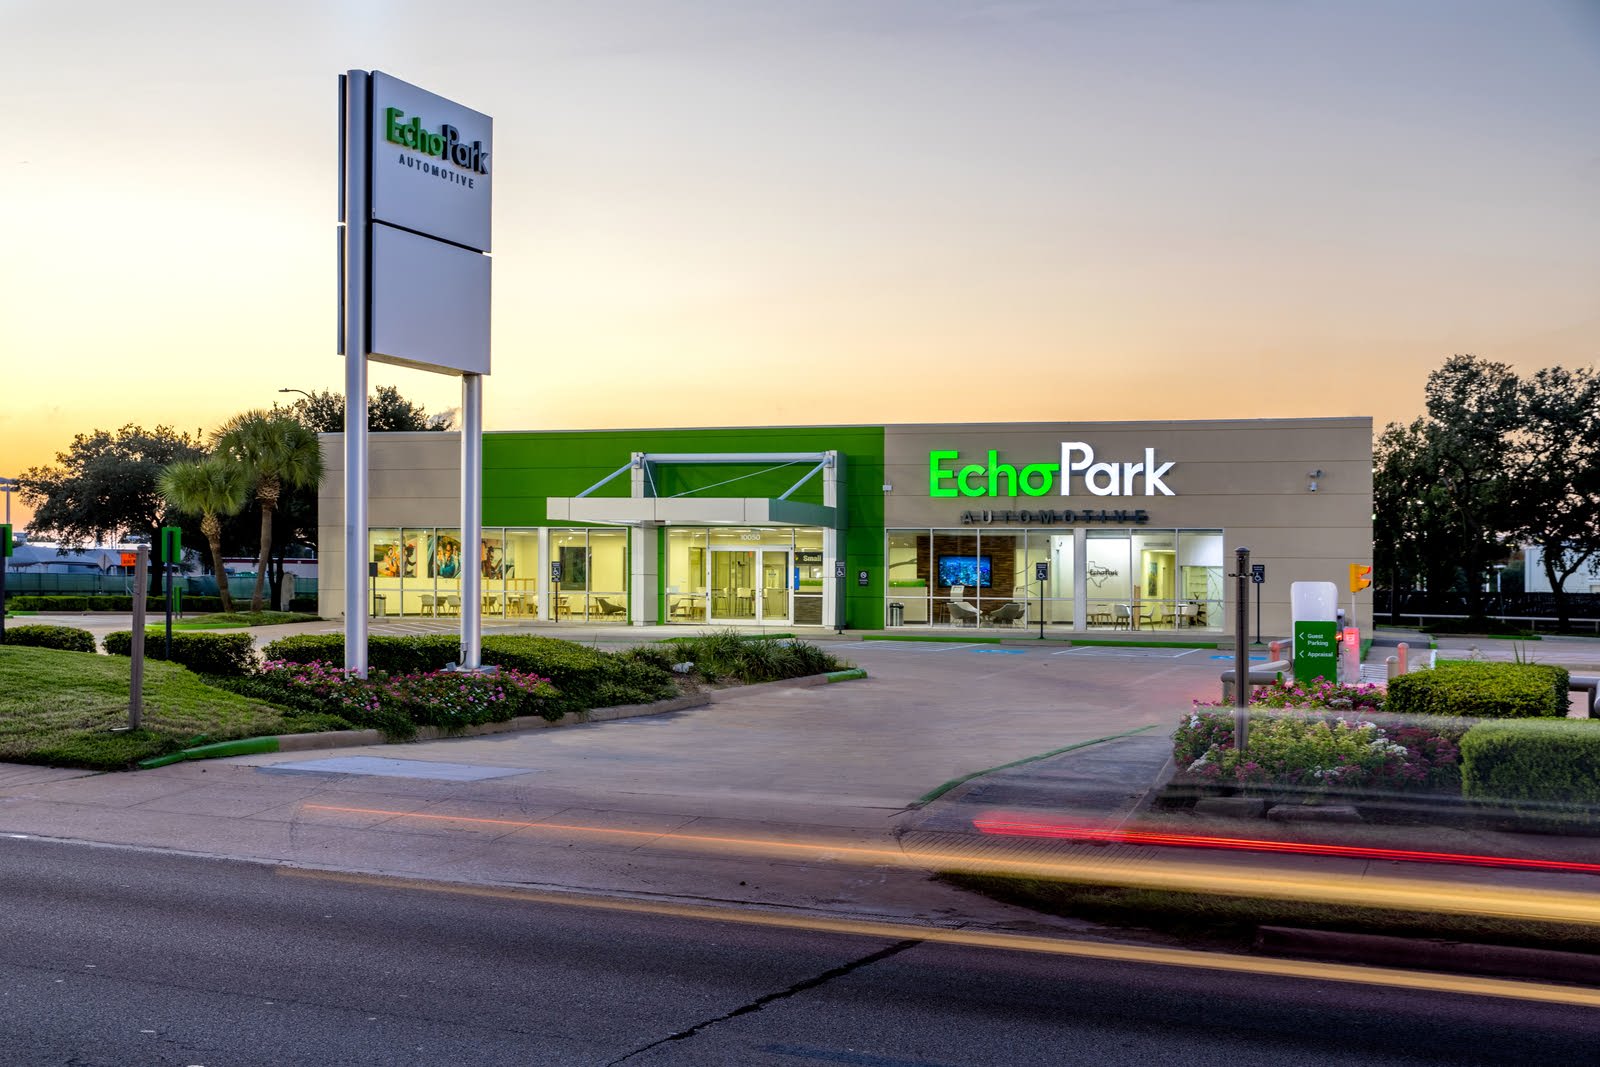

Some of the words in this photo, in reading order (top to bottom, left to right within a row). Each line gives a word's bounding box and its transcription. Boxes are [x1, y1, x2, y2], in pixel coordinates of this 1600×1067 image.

[386, 107, 489, 175] EchoPark
[399, 153, 474, 189] AUTOMOTIVE
[929, 441, 1176, 498] EchoPark
[961, 509, 1149, 526] AUTOMOTIVE
